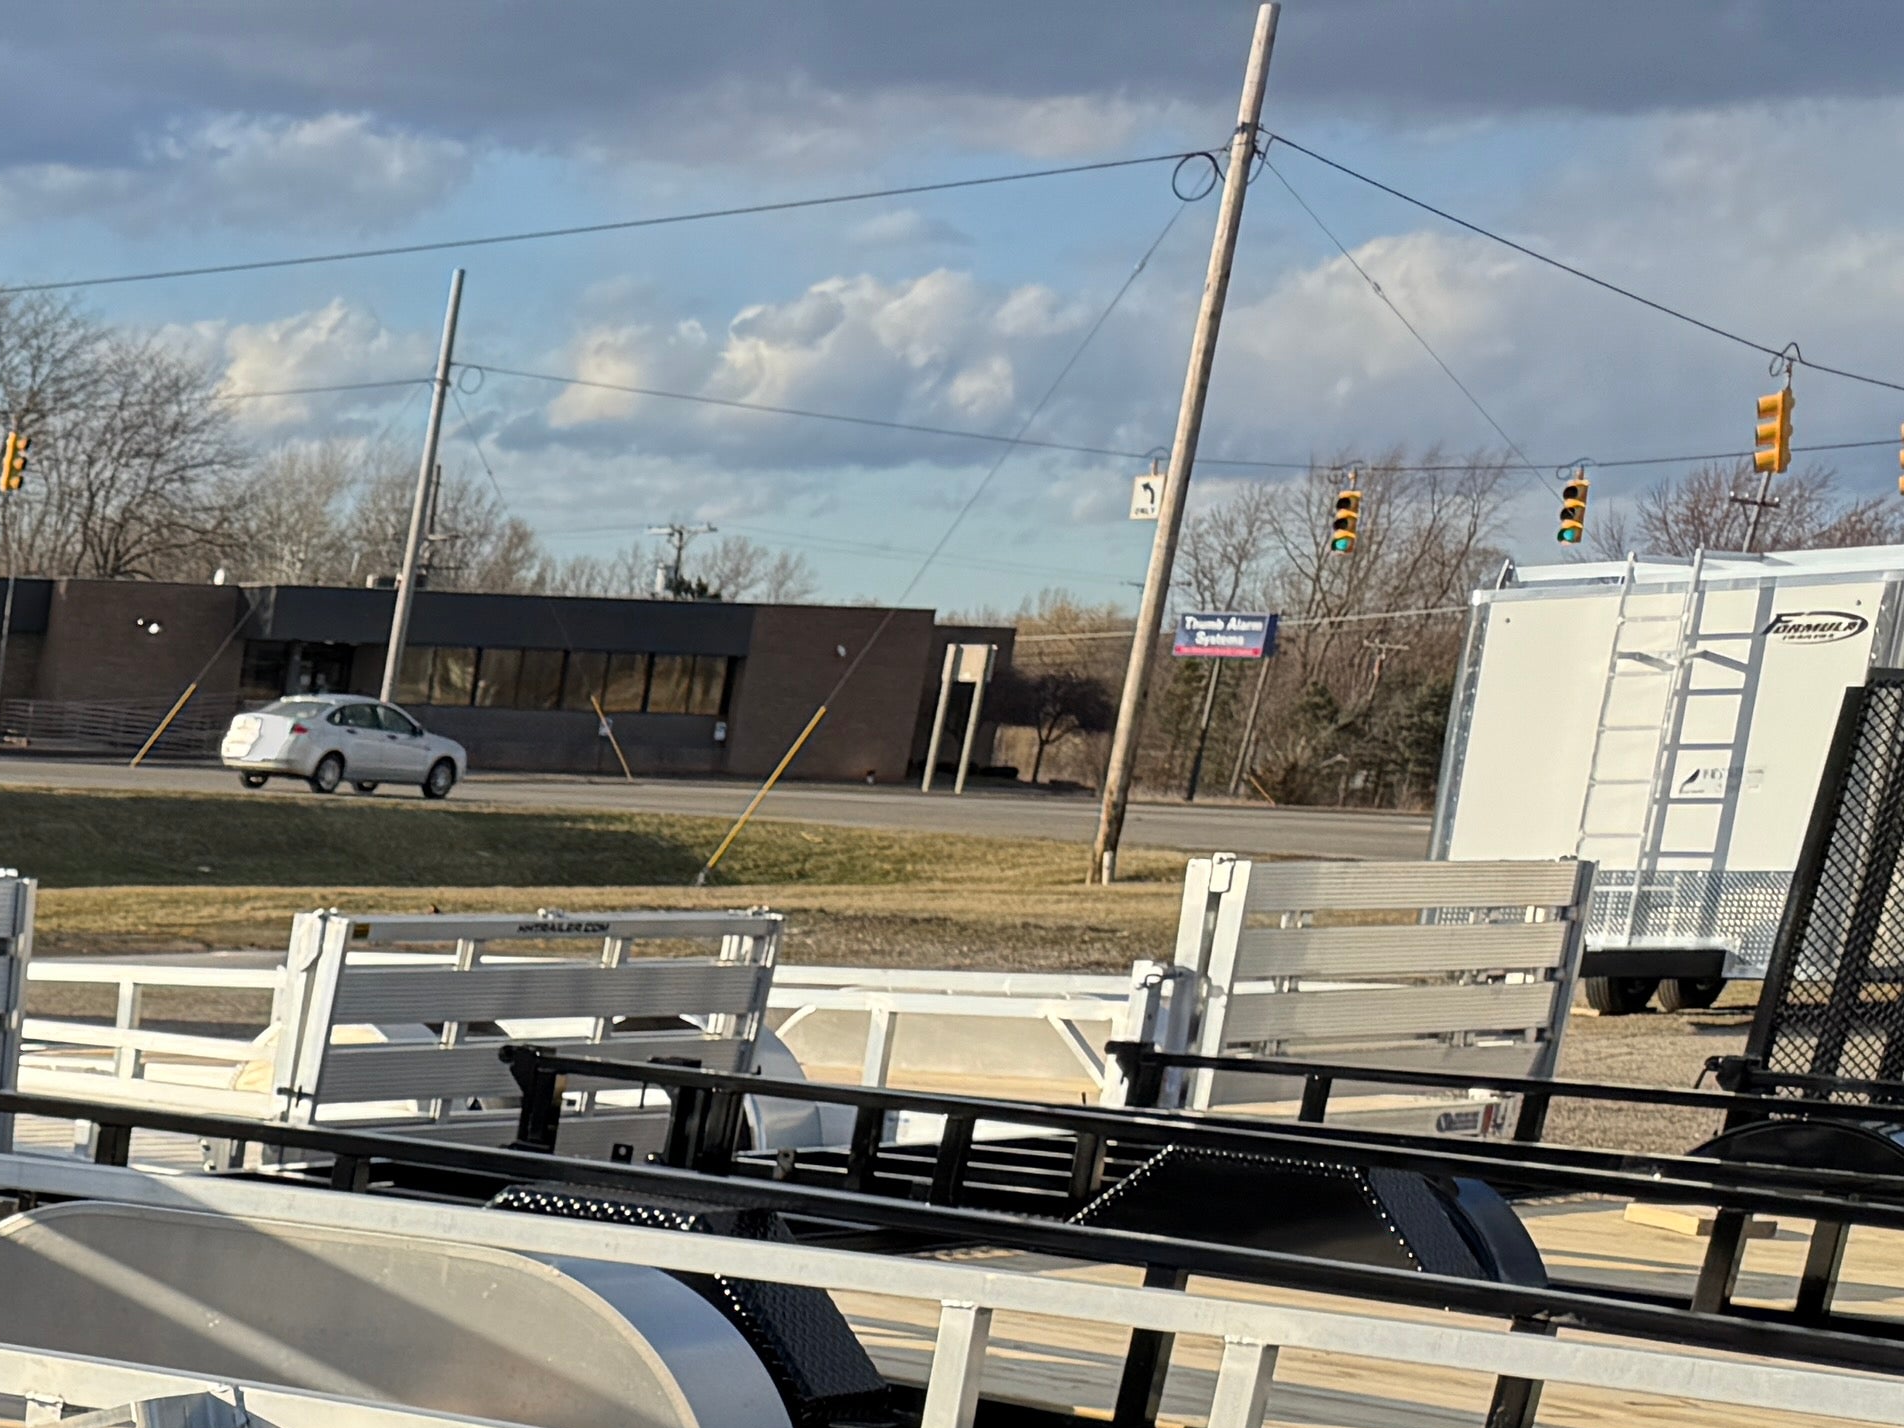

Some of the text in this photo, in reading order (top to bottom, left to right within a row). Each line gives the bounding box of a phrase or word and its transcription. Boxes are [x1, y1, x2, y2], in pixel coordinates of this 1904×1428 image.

[1185, 616, 1263, 631] Thumb Alarm
[1760, 611, 1859, 635] FORMULA
[1195, 630, 1244, 647] Systems
